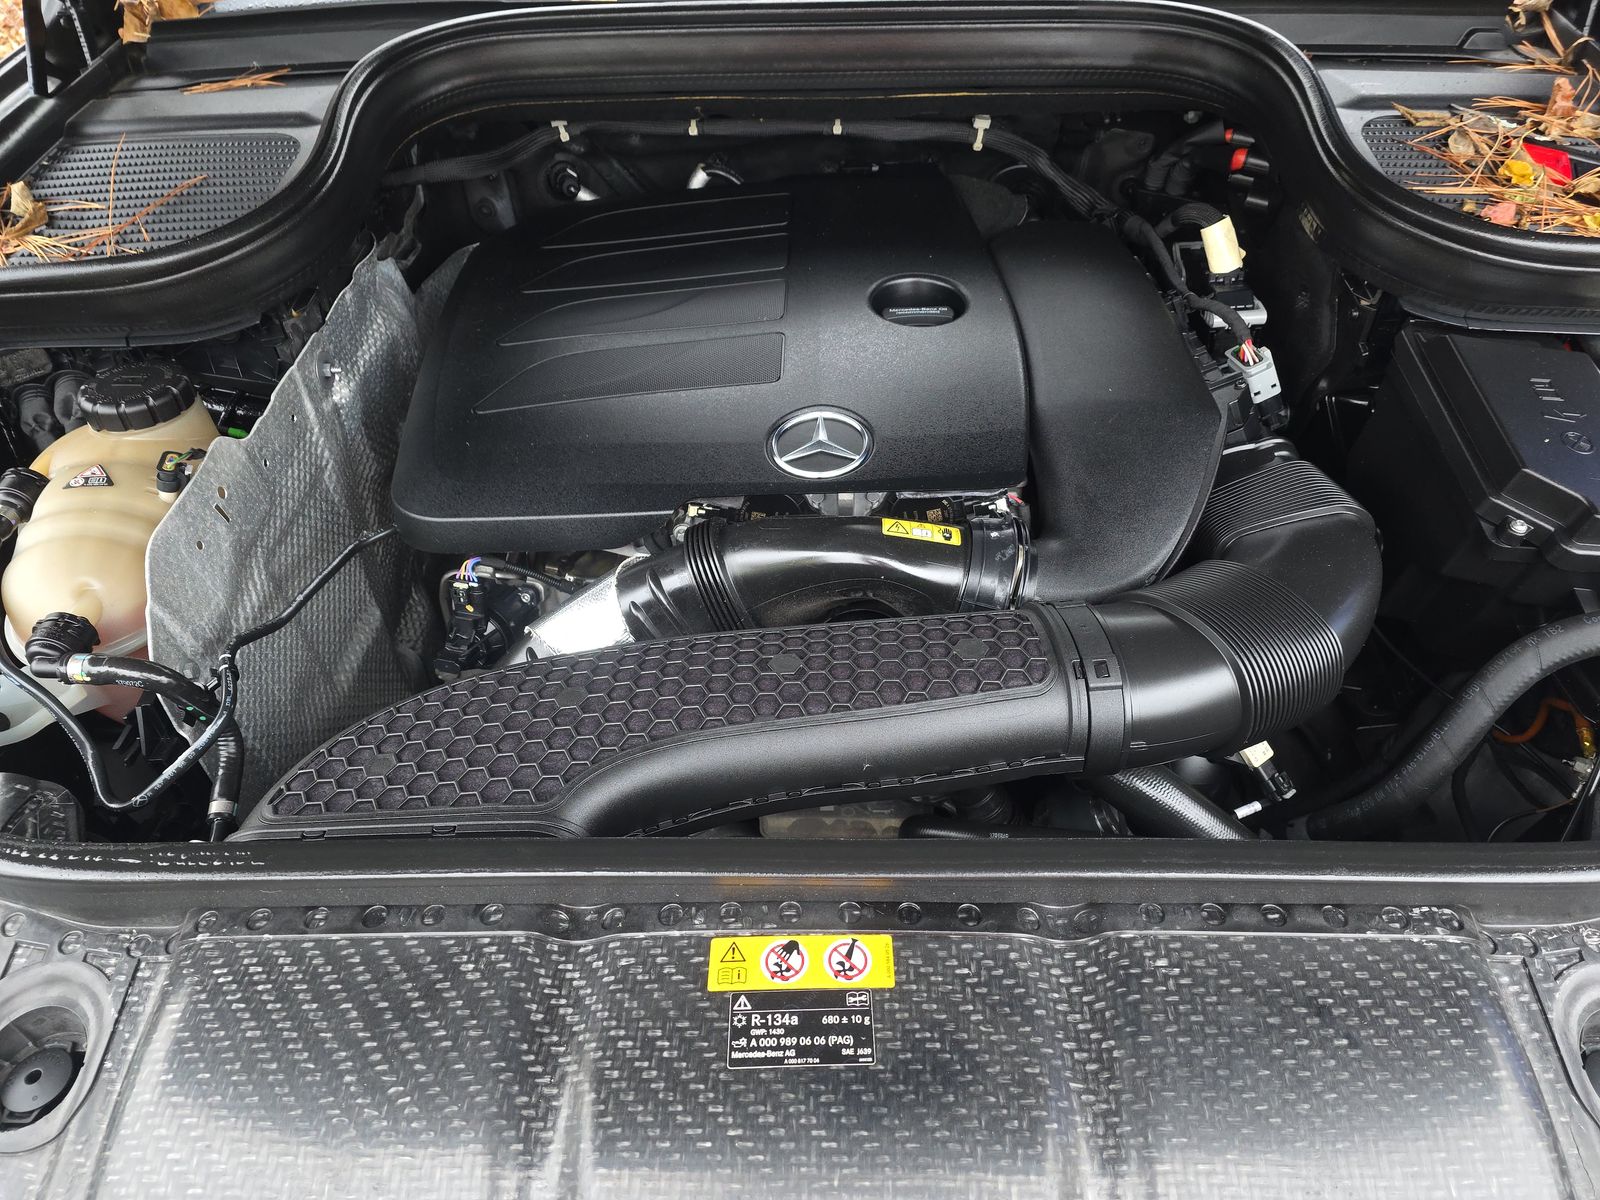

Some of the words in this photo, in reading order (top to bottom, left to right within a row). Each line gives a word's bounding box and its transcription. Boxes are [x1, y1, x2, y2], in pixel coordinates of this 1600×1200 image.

[751, 1014, 799, 1026] R-134a
[822, 1015, 839, 1024] 680
[851, 1014, 862, 1023] 10
[864, 1016, 871, 1025] g
[749, 1040, 757, 1048] A
[759, 1039, 777, 1047] 000
[780, 1038, 797, 1047] 989
[799, 1037, 811, 1046] 06
[813, 1037, 826, 1045] 06
[828, 1036, 854, 1046] (PAG)
[731, 1050, 783, 1059] Mercedes-Benz
[784, 1049, 796, 1057] AG
